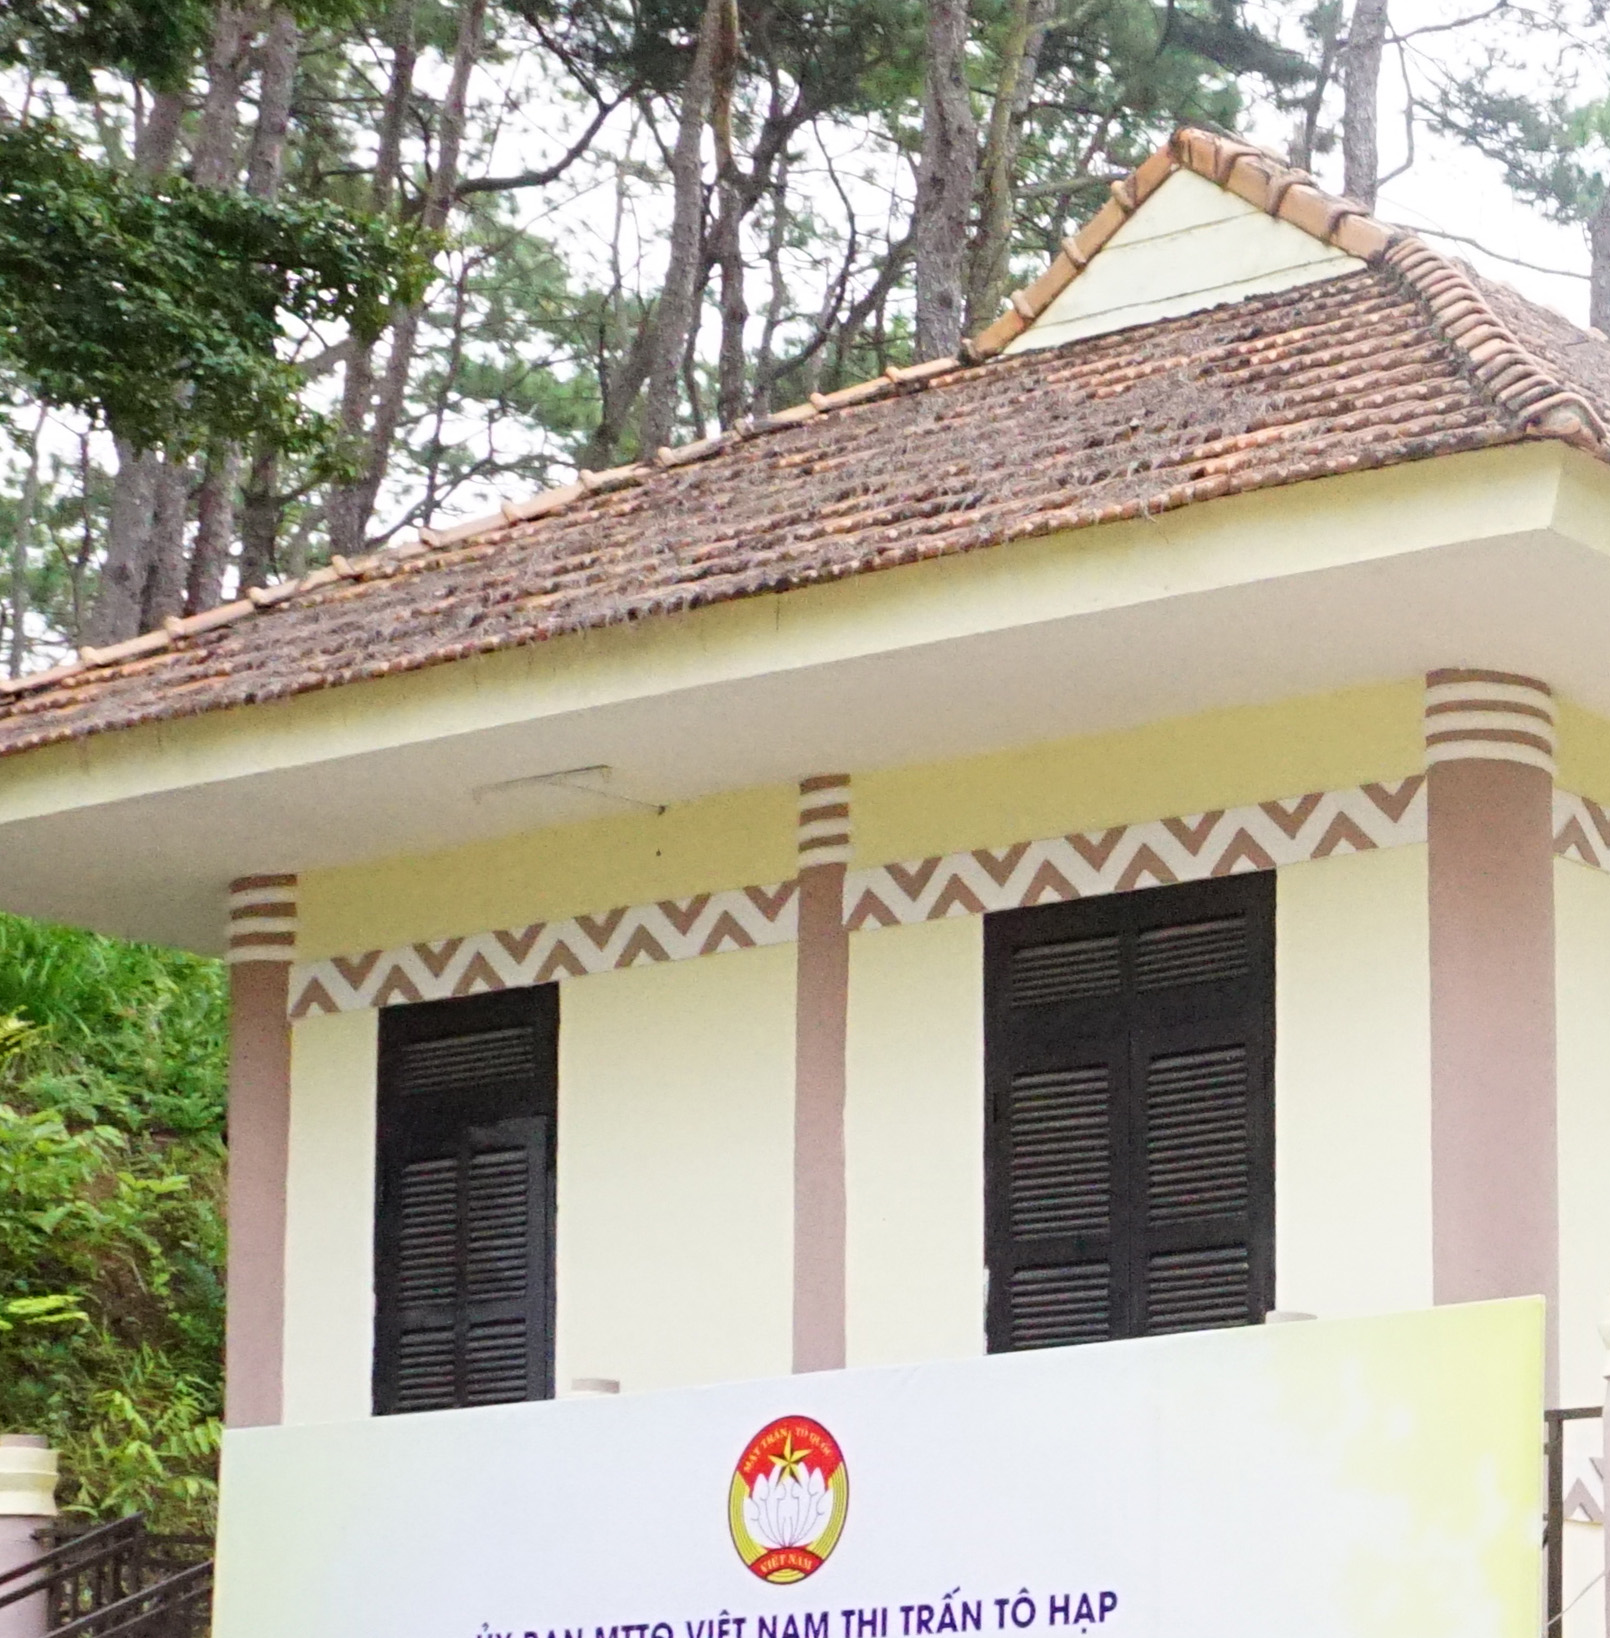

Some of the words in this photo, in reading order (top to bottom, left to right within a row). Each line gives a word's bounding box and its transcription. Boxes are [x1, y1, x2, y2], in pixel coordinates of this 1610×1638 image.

[900, 1586, 982, 1636] TRẤN
[994, 1587, 1036, 1629] TÔ
[1049, 1591, 1117, 1634] HẠP
